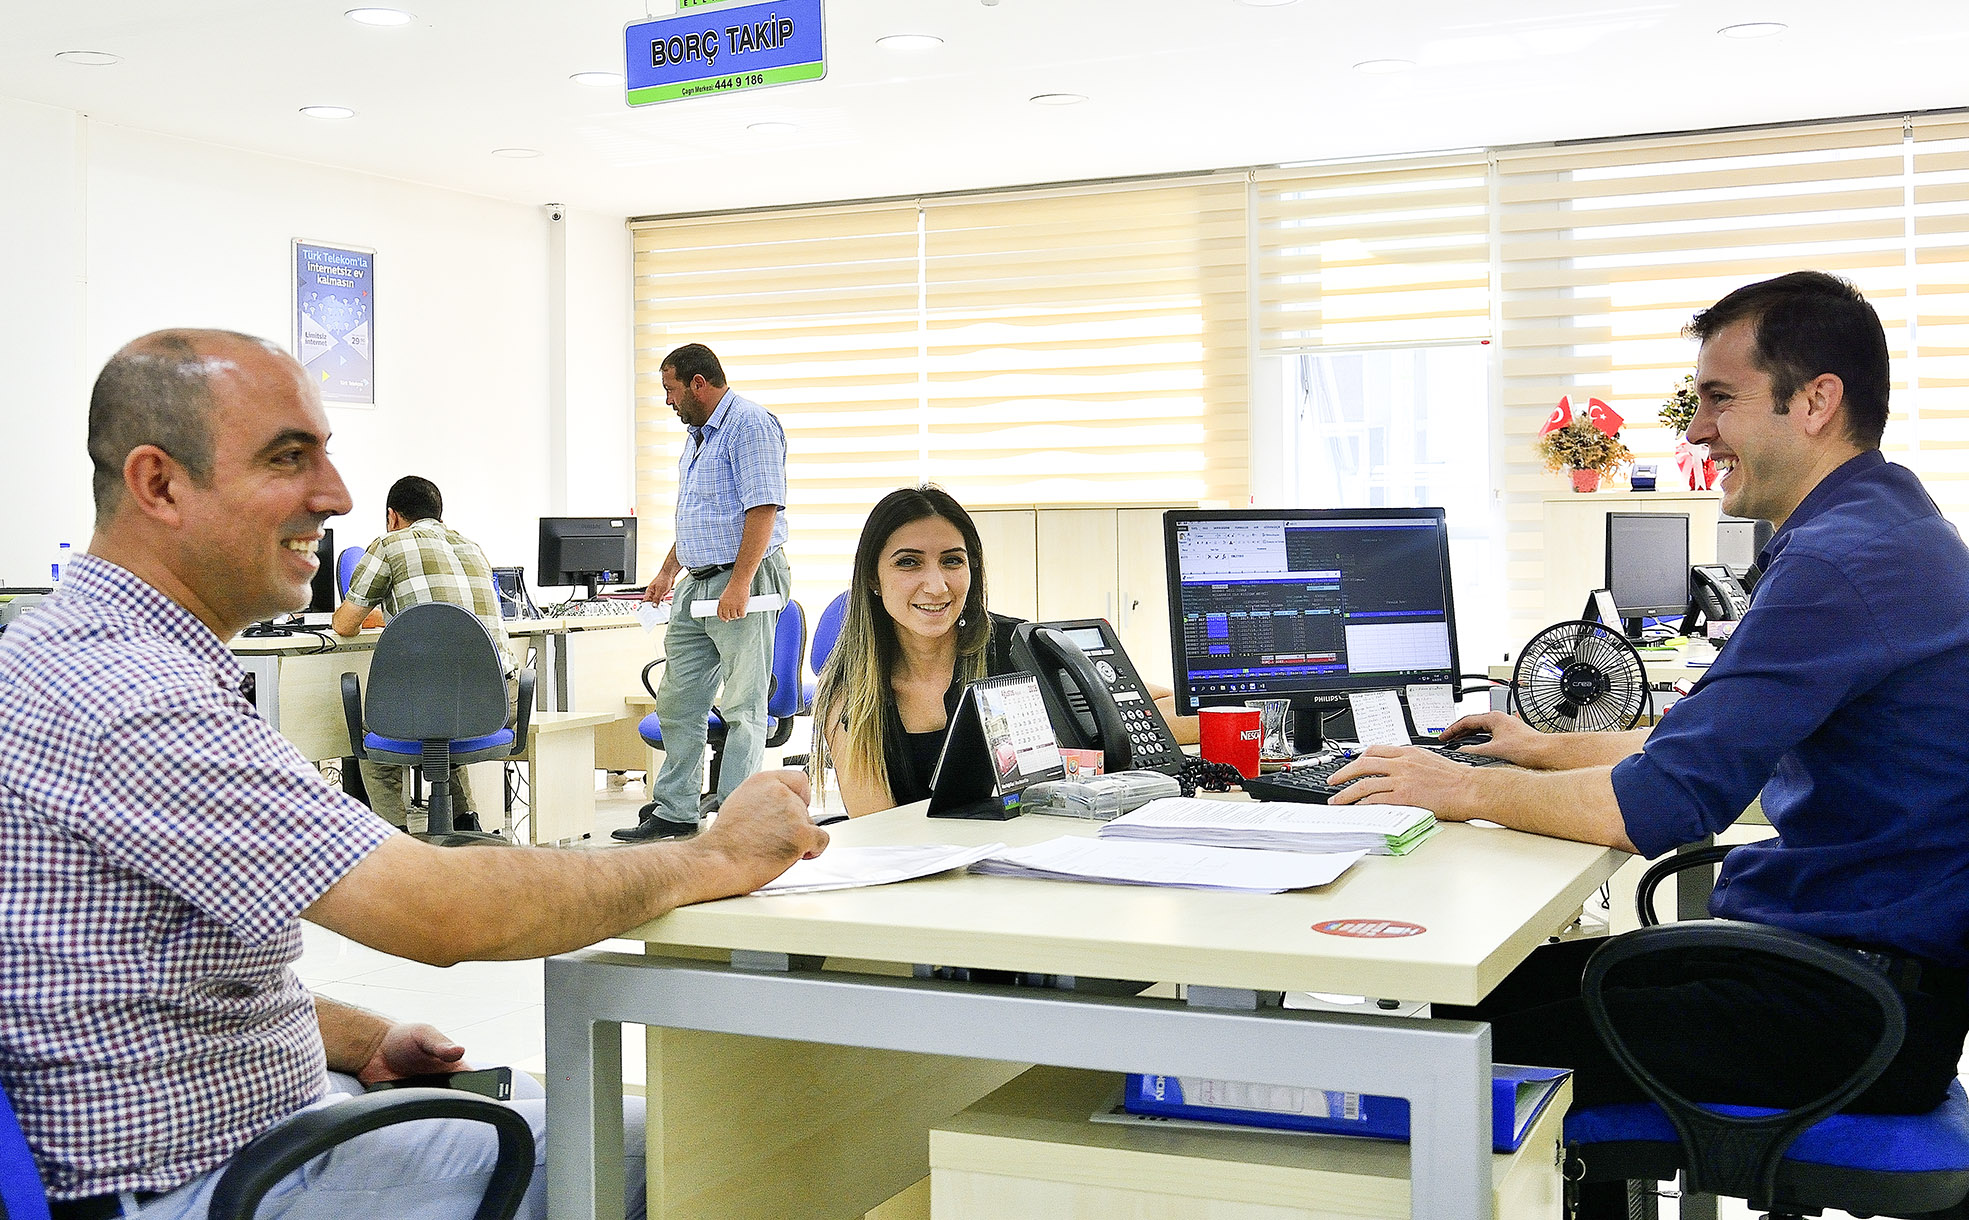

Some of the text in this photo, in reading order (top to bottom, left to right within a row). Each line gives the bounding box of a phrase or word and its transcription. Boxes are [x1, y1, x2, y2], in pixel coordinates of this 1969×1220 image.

[650, 13, 794, 67] BORÇ TAKİP
[714, 78, 733, 90] 444
[735, 77, 742, 87] 9
[745, 74, 763, 86] 186
[303, 250, 368, 267] Türk Telekom'la
[317, 273, 354, 288] kalmasın
[353, 270, 364, 278] ev
[351, 337, 360, 345] 29
[1314, 695, 1339, 703] PHILIPS
